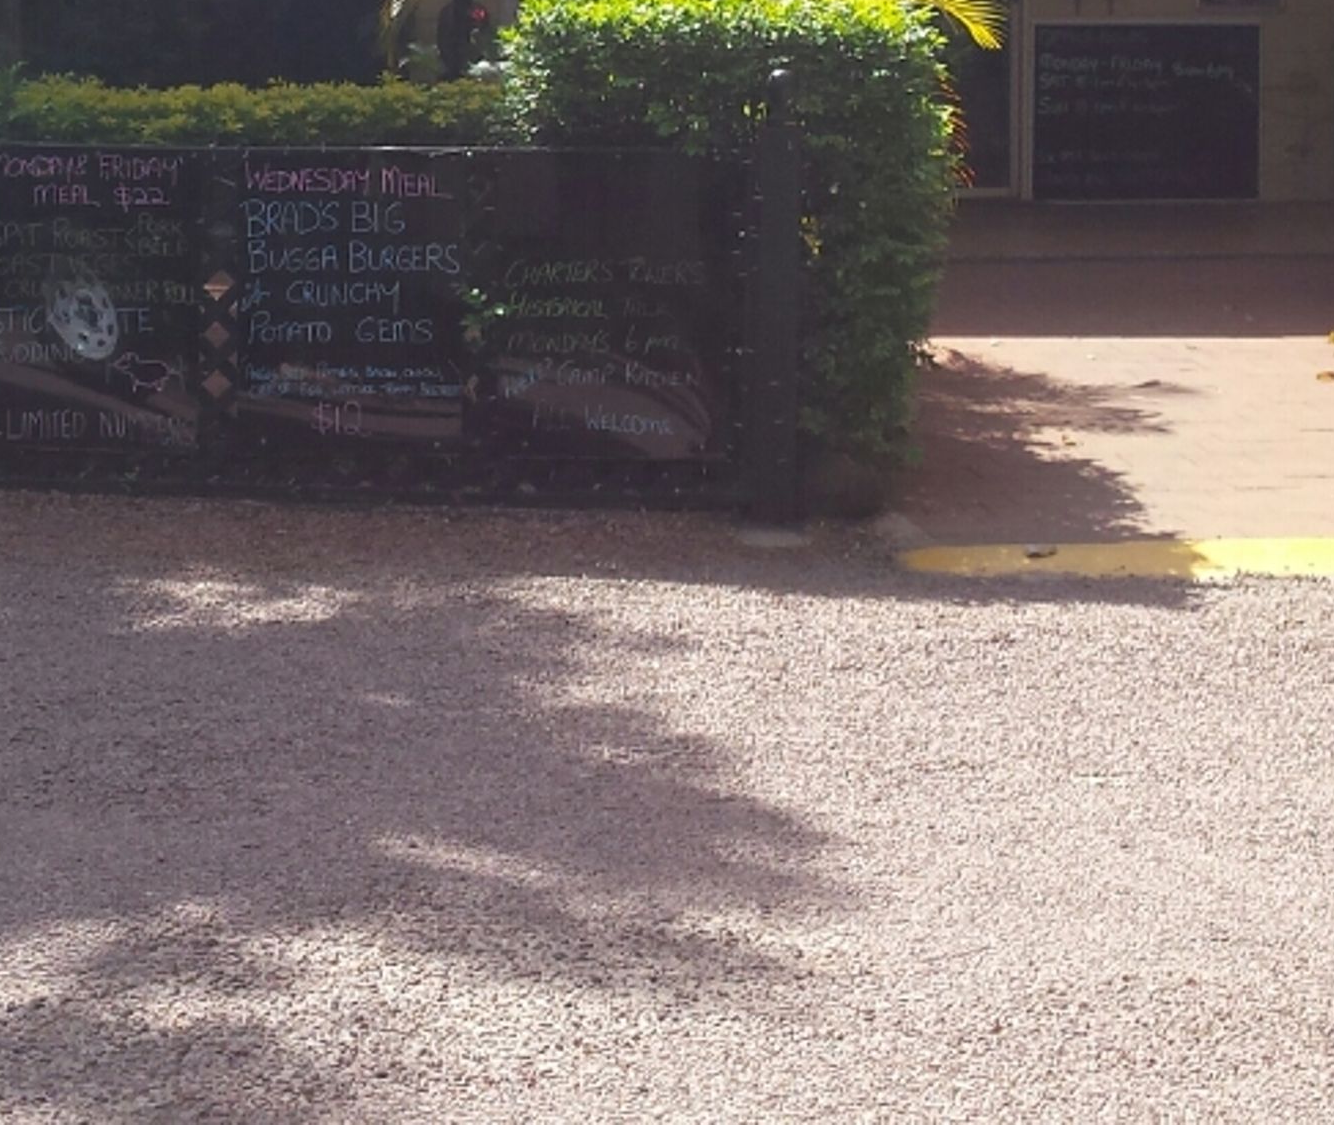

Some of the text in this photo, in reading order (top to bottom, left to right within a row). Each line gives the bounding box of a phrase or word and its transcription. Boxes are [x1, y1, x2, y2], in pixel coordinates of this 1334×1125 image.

[32, 181, 171, 213] MEAL $22
[244, 160, 455, 199] WEDNESDAY MEAL
[239, 197, 407, 238] BRAD'S BIG
[246, 238, 461, 275] BUGGA BURGERS
[284, 279, 401, 315] CRUNCHY
[247, 310, 434, 346] POTATO GEMS
[584, 403, 675, 436] WELCOME
